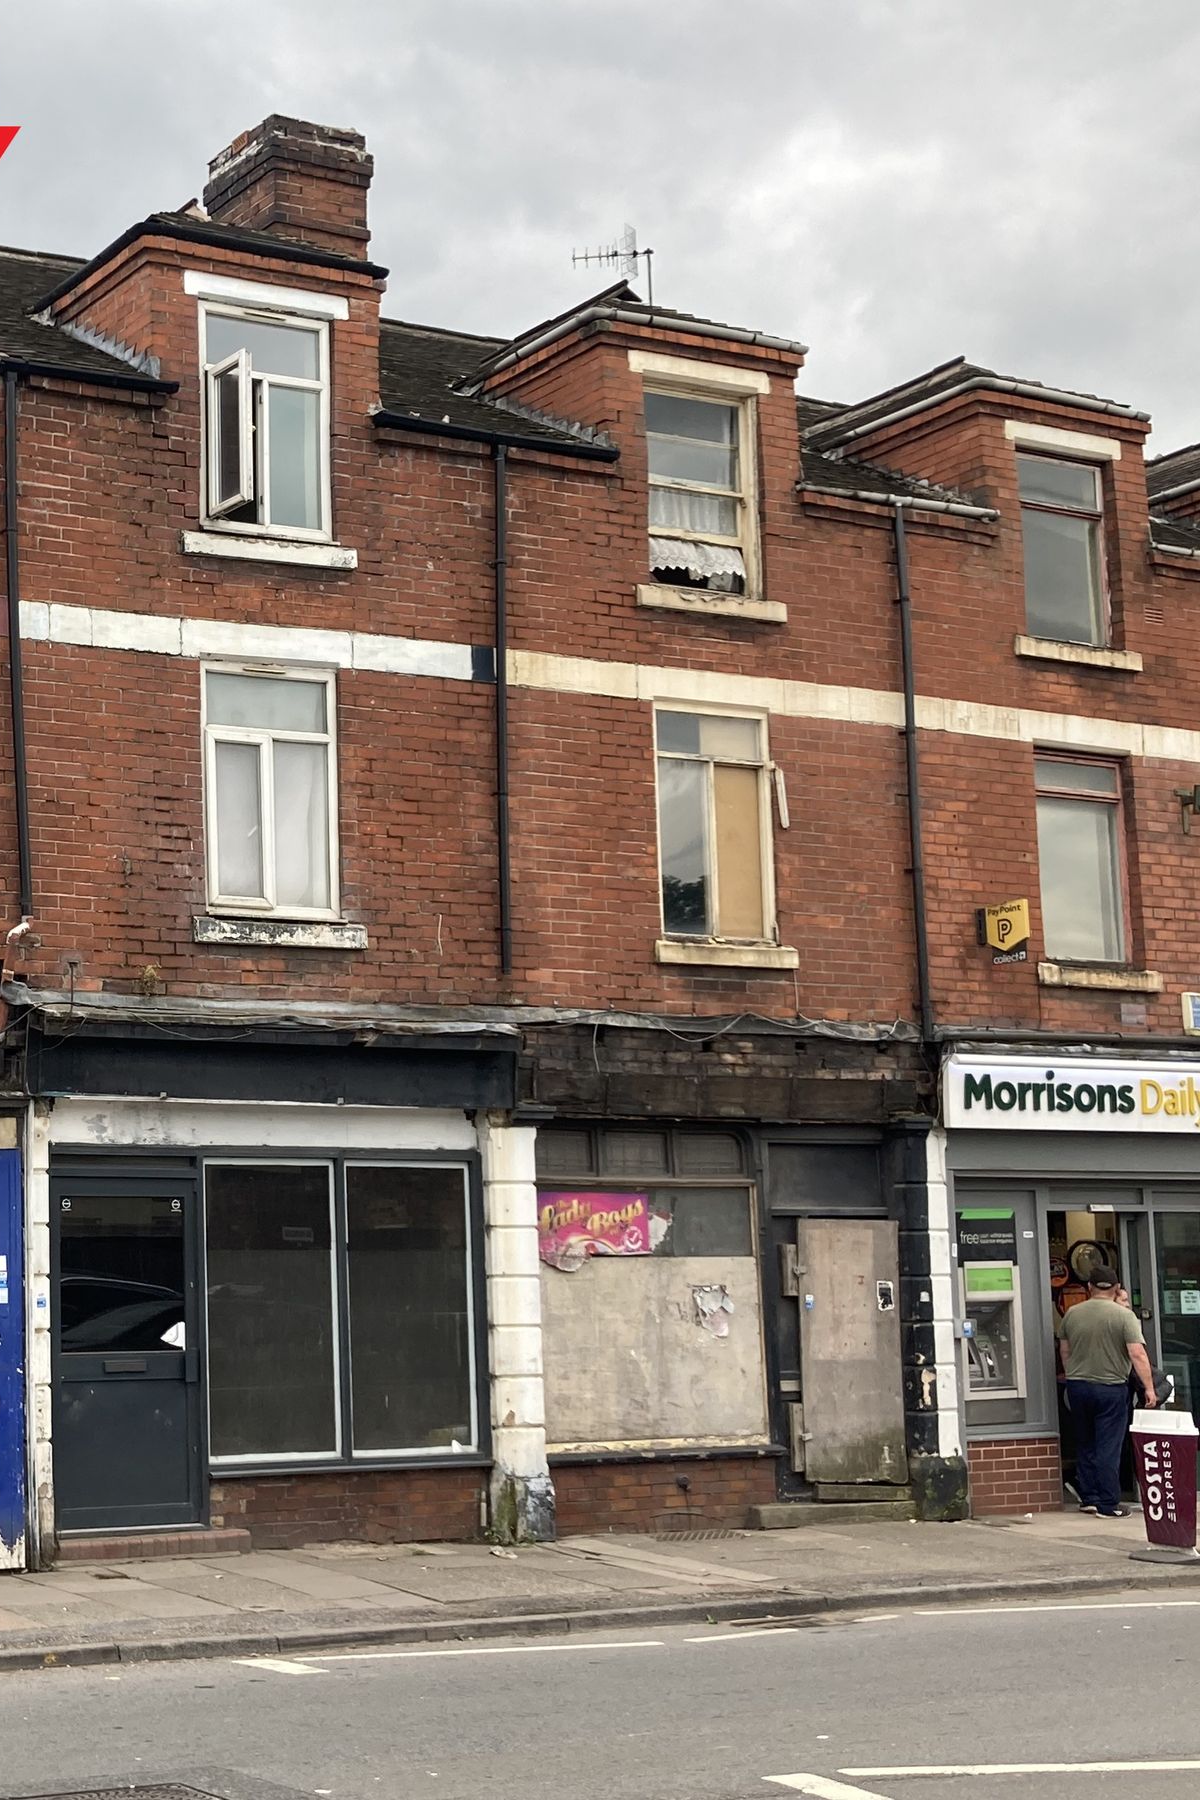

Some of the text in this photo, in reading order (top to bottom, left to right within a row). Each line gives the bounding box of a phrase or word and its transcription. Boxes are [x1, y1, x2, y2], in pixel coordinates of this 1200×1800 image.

[964, 1070, 1135, 1113] Morrisons
[586, 1199, 644, 1237] Boys
[960, 1231, 979, 1244] free
[1143, 1441, 1163, 1521] COSTA
[1162, 1441, 1175, 1511] EXPRESS
